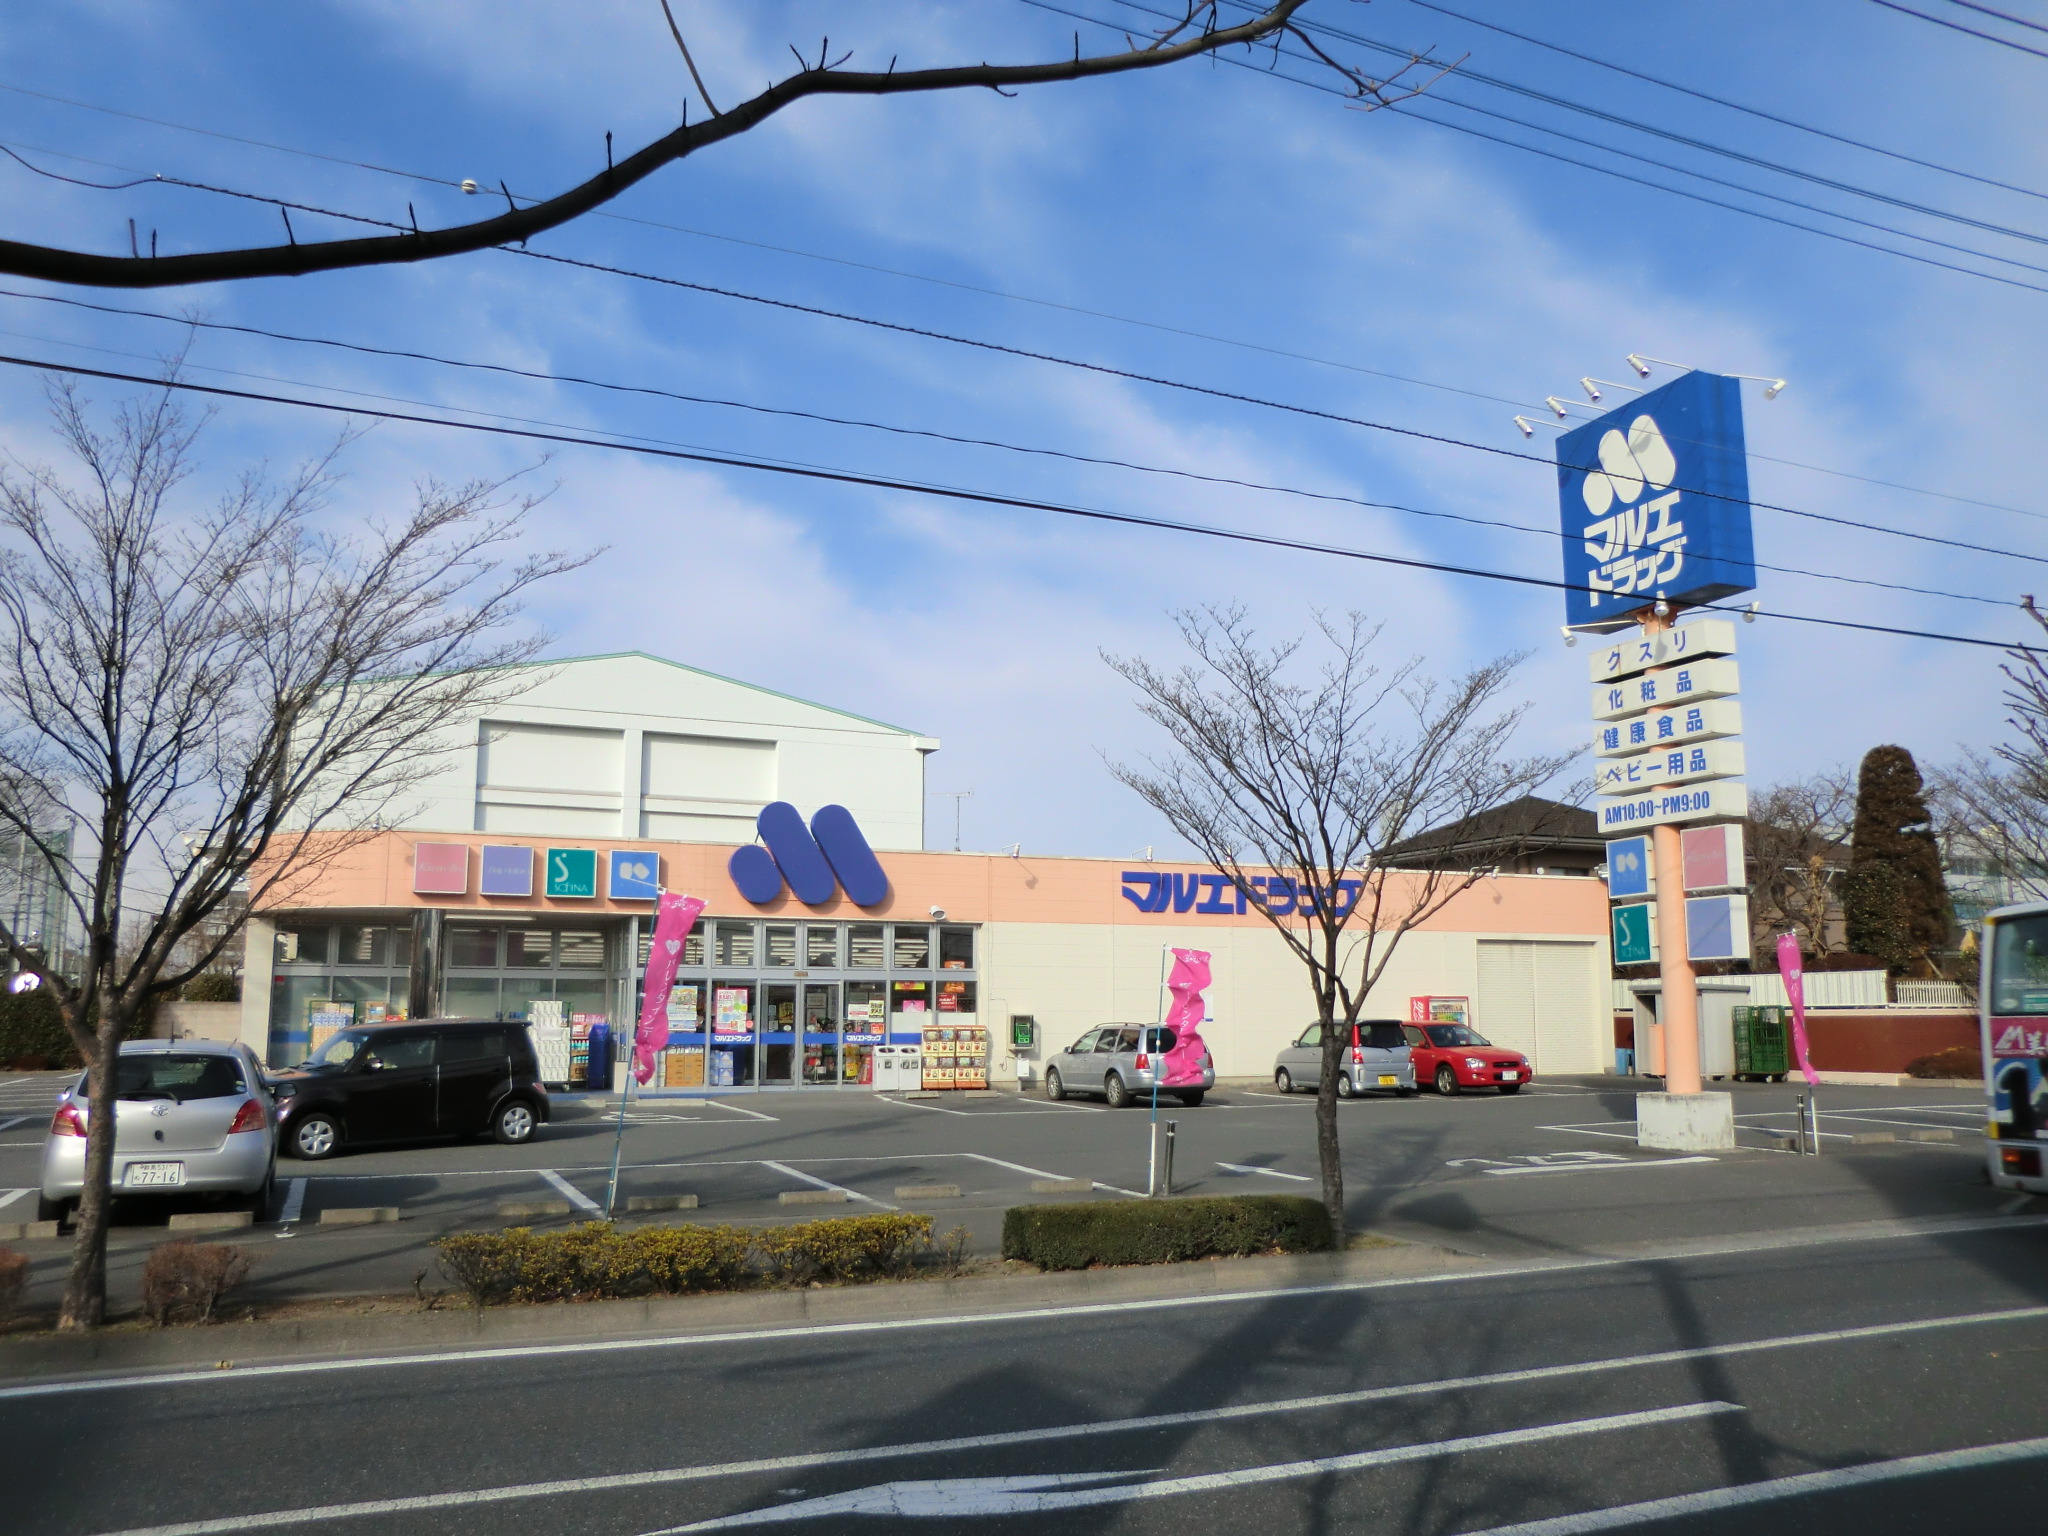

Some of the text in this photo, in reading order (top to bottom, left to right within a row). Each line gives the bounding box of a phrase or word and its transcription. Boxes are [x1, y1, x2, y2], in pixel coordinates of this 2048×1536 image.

[1583, 490, 1683, 563] マルエ
[1588, 535, 1687, 608] ドラッグ
[1606, 630, 1687, 672] クスリ
[1607, 670, 1692, 711] 化粧品
[1602, 707, 1703, 751] 健康食品
[1605, 748, 1707, 783] ベビー用品
[142, 1171, 176, 1183] 77-16
